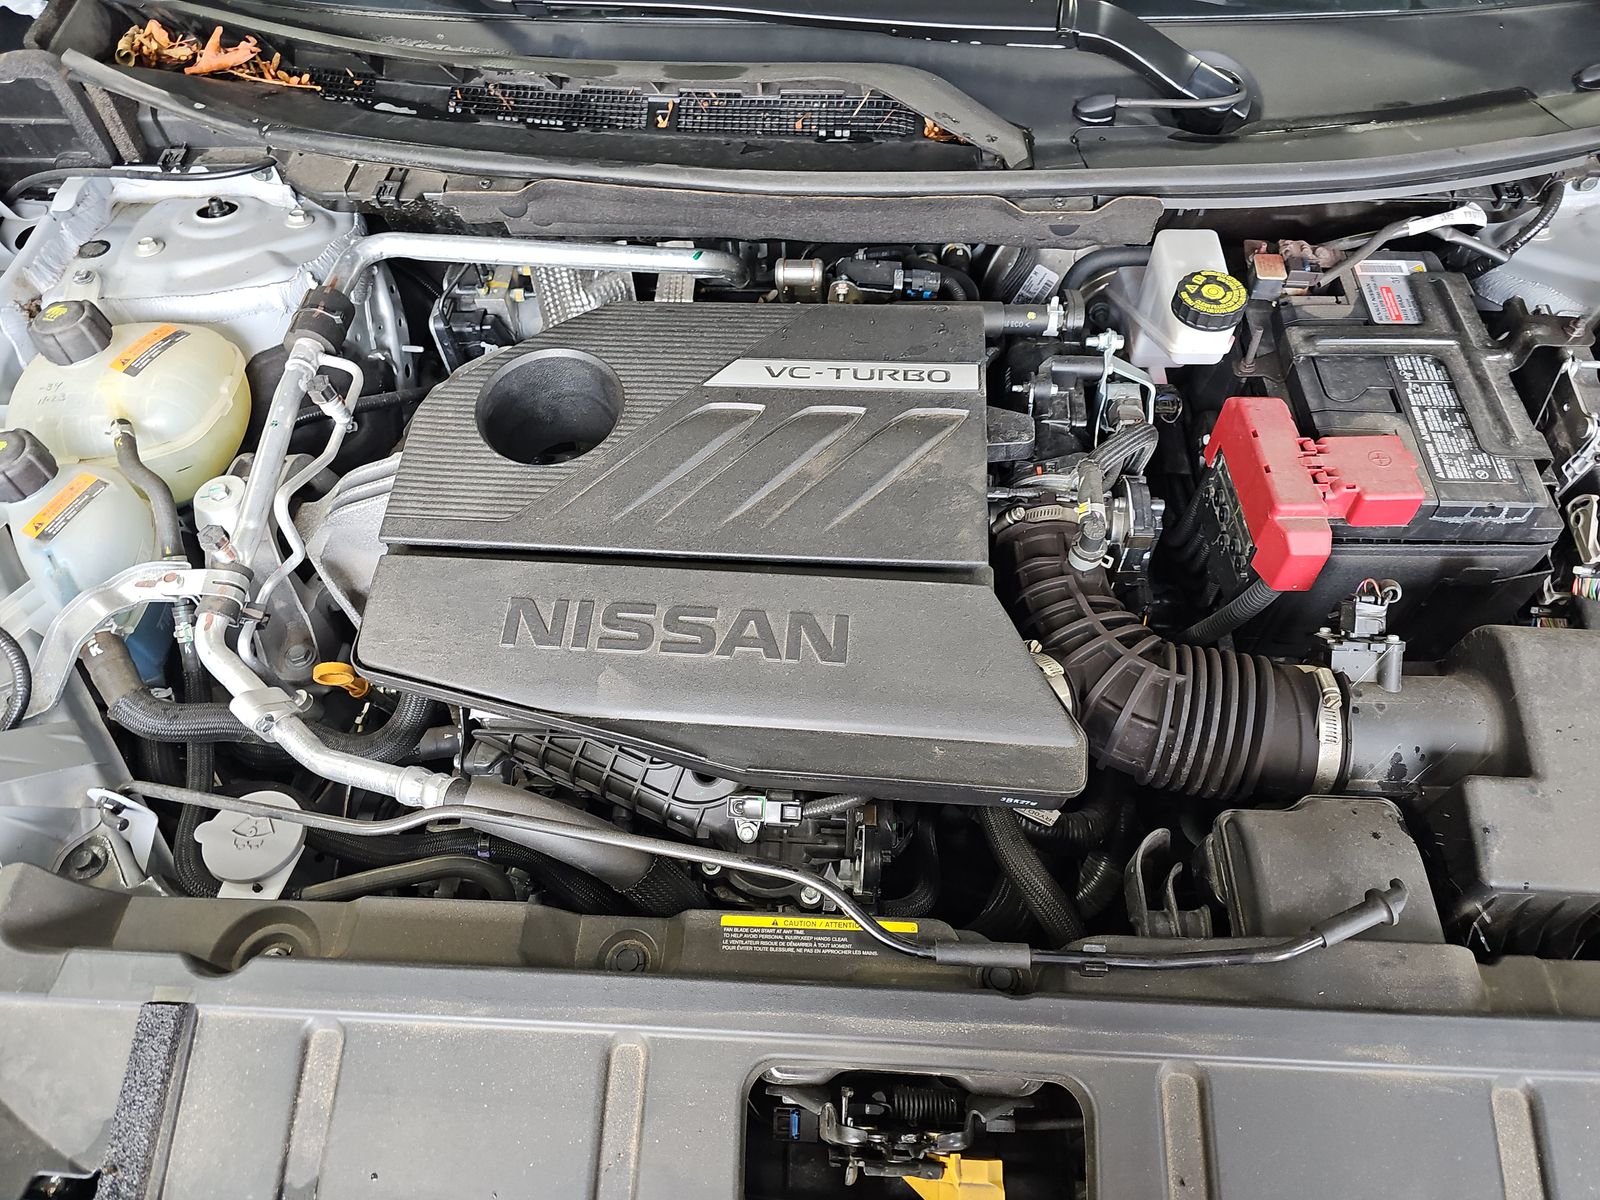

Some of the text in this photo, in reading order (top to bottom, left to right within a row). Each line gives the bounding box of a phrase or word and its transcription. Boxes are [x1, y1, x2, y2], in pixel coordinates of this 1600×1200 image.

[764, 364, 952, 384] VC-TURBO
[499, 596, 850, 666] NISSAN
[783, 919, 817, 928] CAUTION
[825, 920, 860, 929] ATTENTIO
